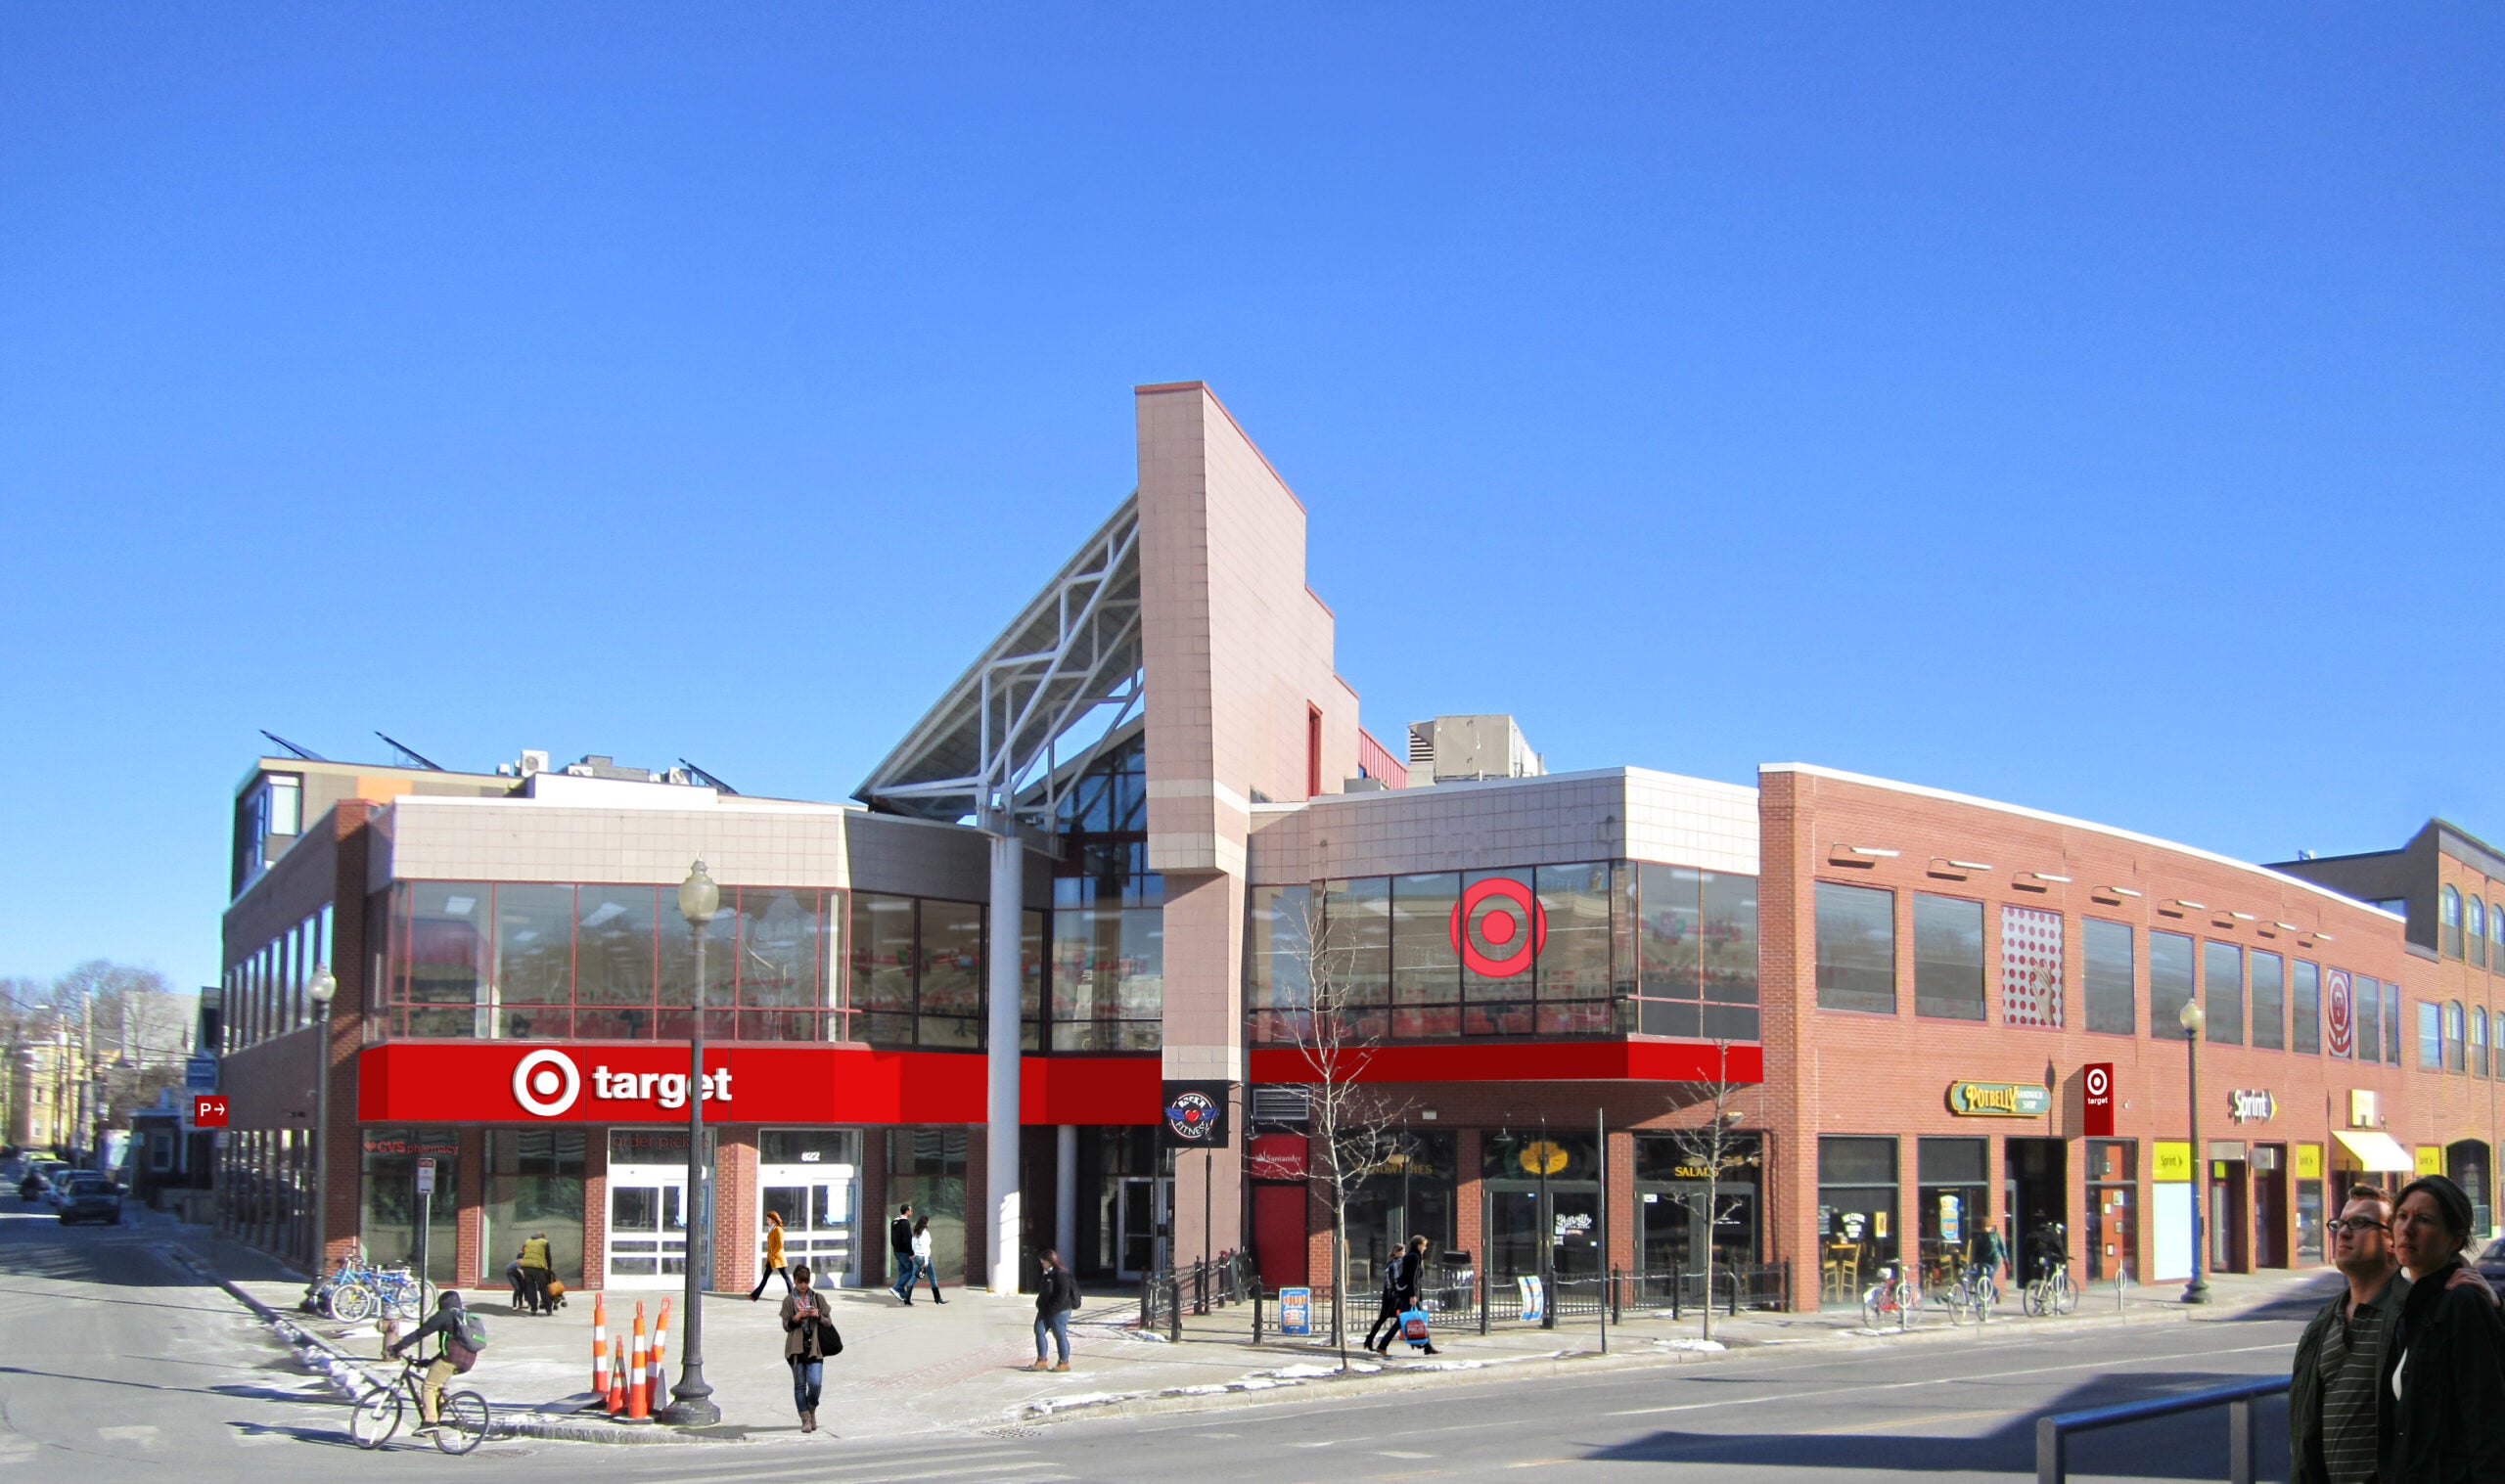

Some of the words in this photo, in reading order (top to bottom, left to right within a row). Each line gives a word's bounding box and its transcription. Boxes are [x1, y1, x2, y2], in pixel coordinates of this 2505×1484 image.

[592, 1065, 732, 1108] target
[1966, 1084, 2019, 1112] POTBELLY
[2087, 1097, 2109, 1106] target
[200, 1102, 211, 1117] P
[2234, 1089, 2266, 1124] Sprint
[377, 1141, 406, 1153] CVS
[406, 1143, 460, 1155] pharmacy
[612, 1135, 653, 1148] order
[658, 1135, 712, 1150] pickp
